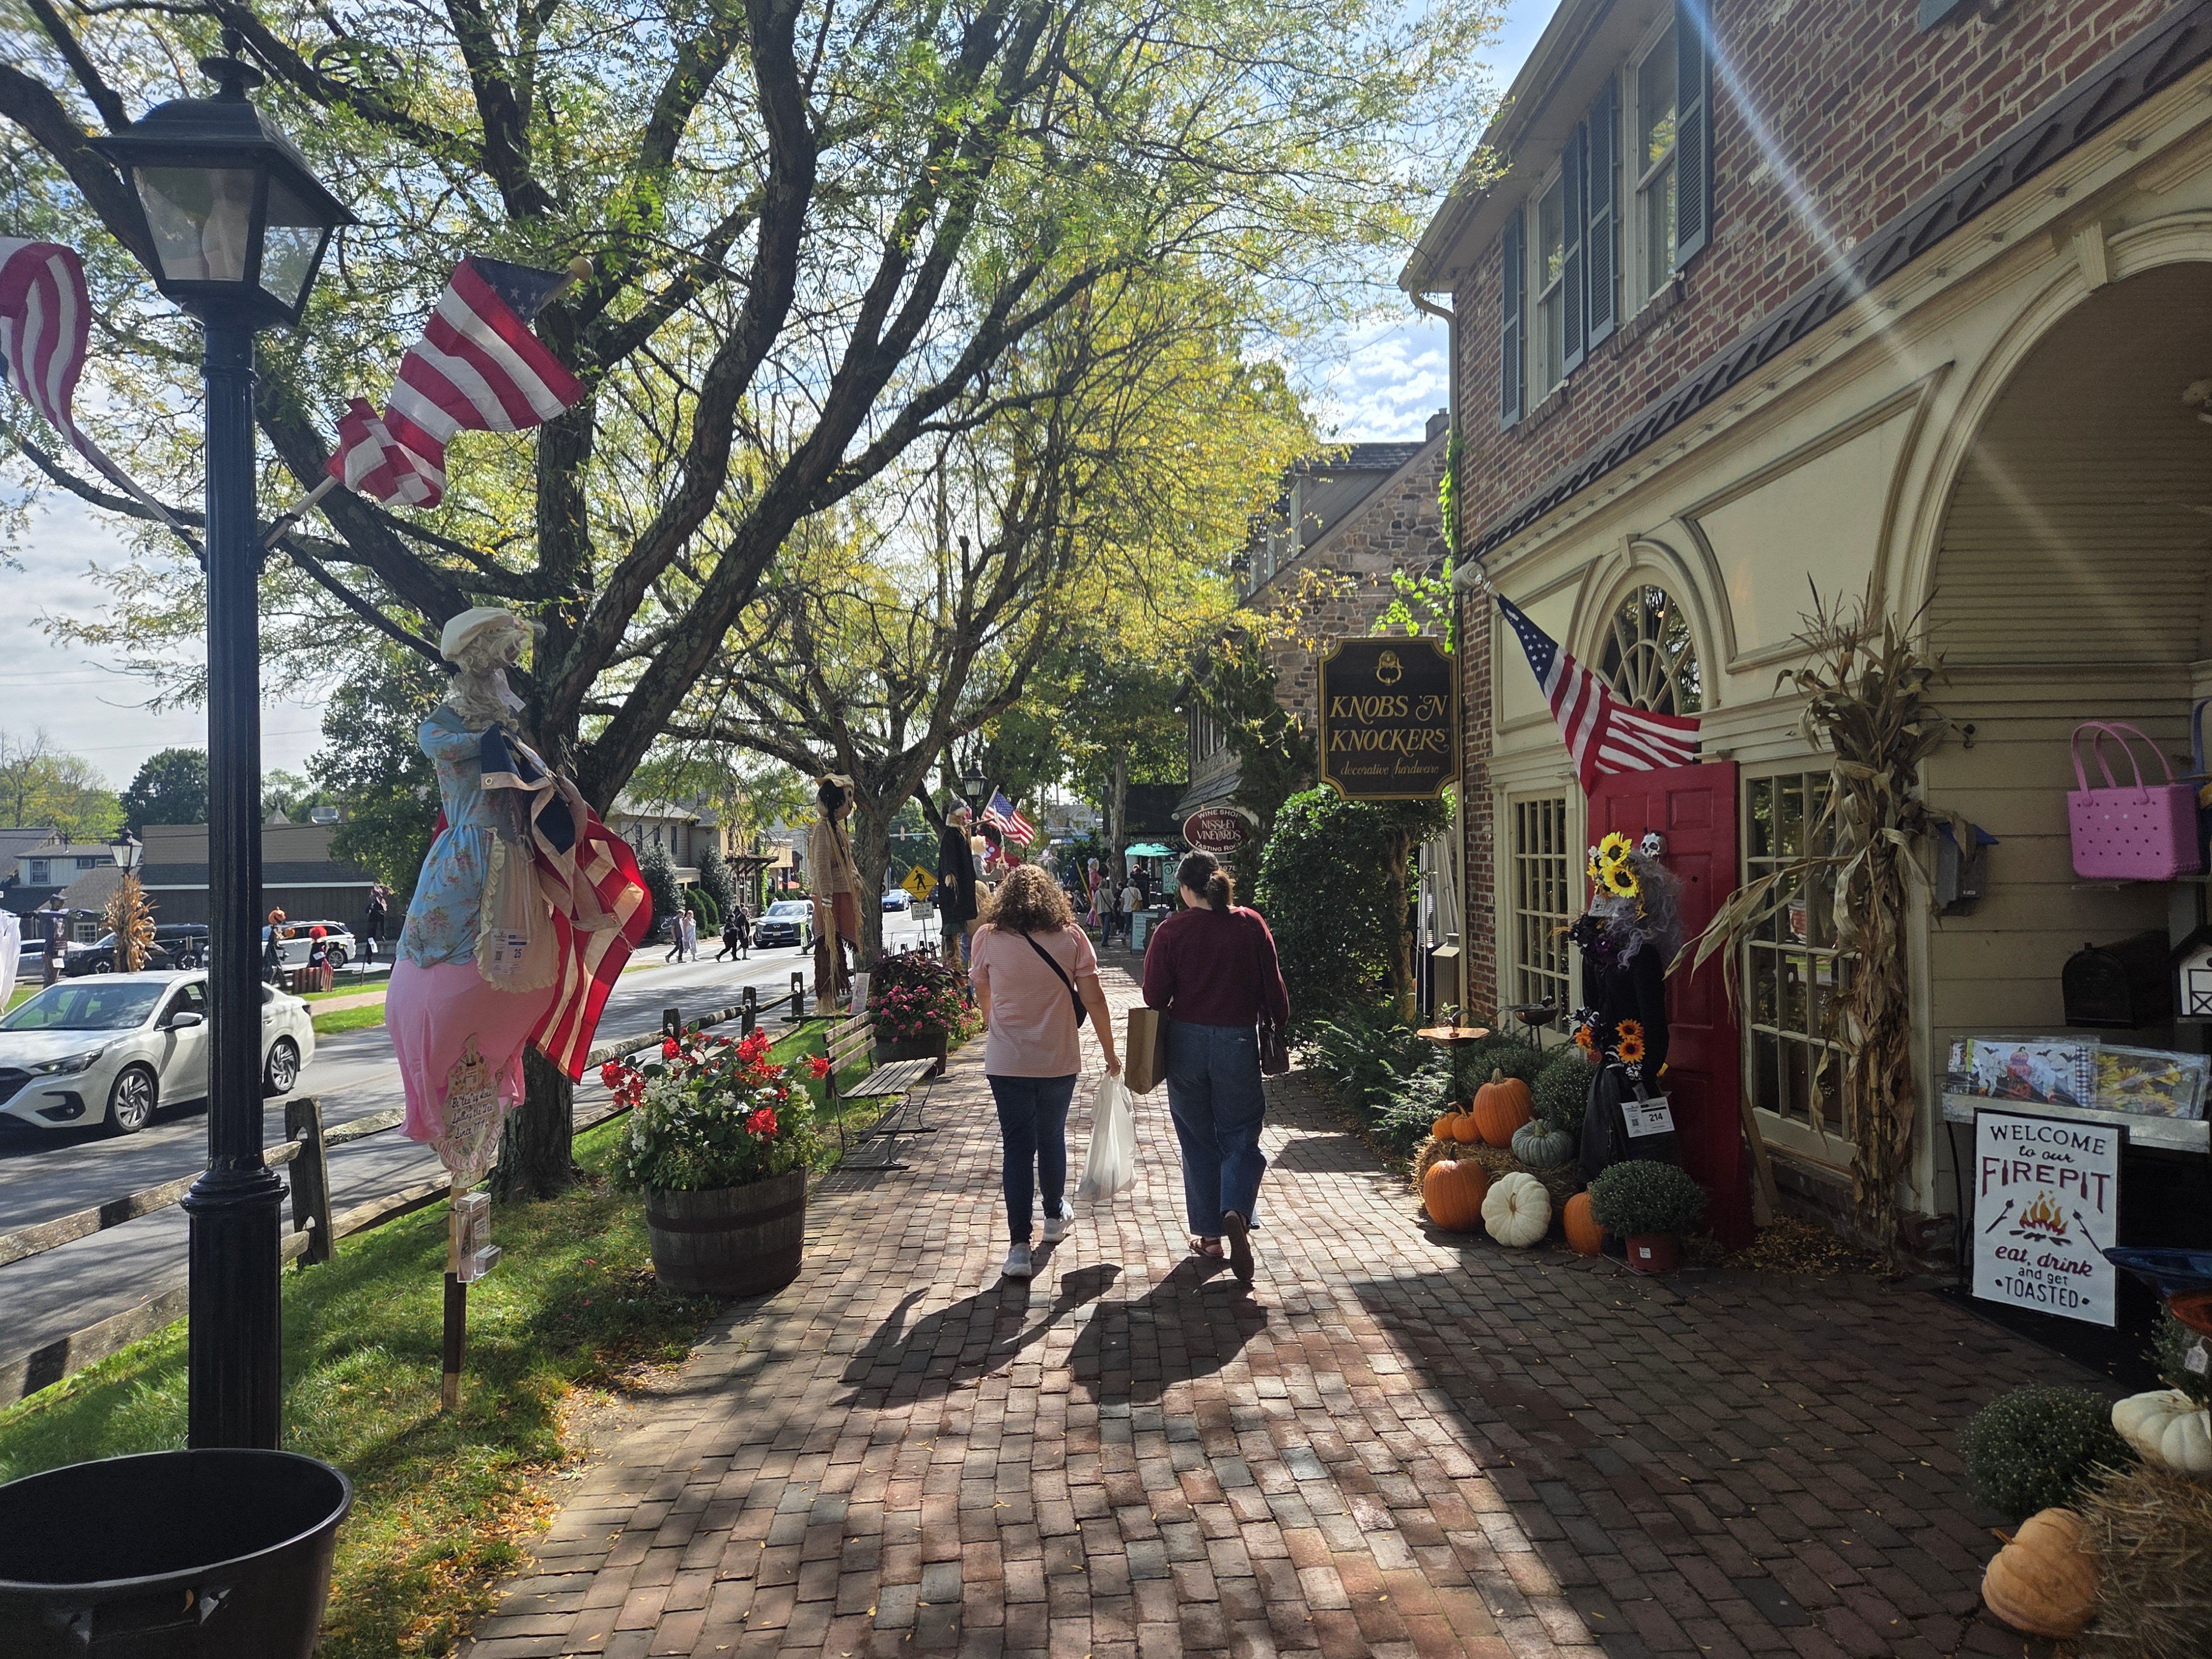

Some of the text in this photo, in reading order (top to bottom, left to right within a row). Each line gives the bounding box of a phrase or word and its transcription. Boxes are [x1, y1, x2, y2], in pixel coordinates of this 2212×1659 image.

[1329, 695, 1408, 724] KNOBS
[1329, 728, 1449, 757] KNOCKERS
[1340, 757, 1439, 779] decorative hardware
[1197, 809, 1218, 819] WINE
[1202, 820, 1236, 831] NISSLEY
[1197, 830, 1241, 841] VINEYARDS
[1195, 840, 1222, 852] TASTING
[514, 948, 521, 958] 25
[1649, 1113, 1663, 1121] 214
[1990, 1124, 2106, 1156] WELCOME
[2018, 1145, 2075, 1164] to our
[1982, 1156, 2110, 1214] FIREPIT
[1995, 1245, 2093, 1277] eat, drink
[2018, 1267, 2068, 1286] and get
[2005, 1276, 2079, 1308] TOASTED
